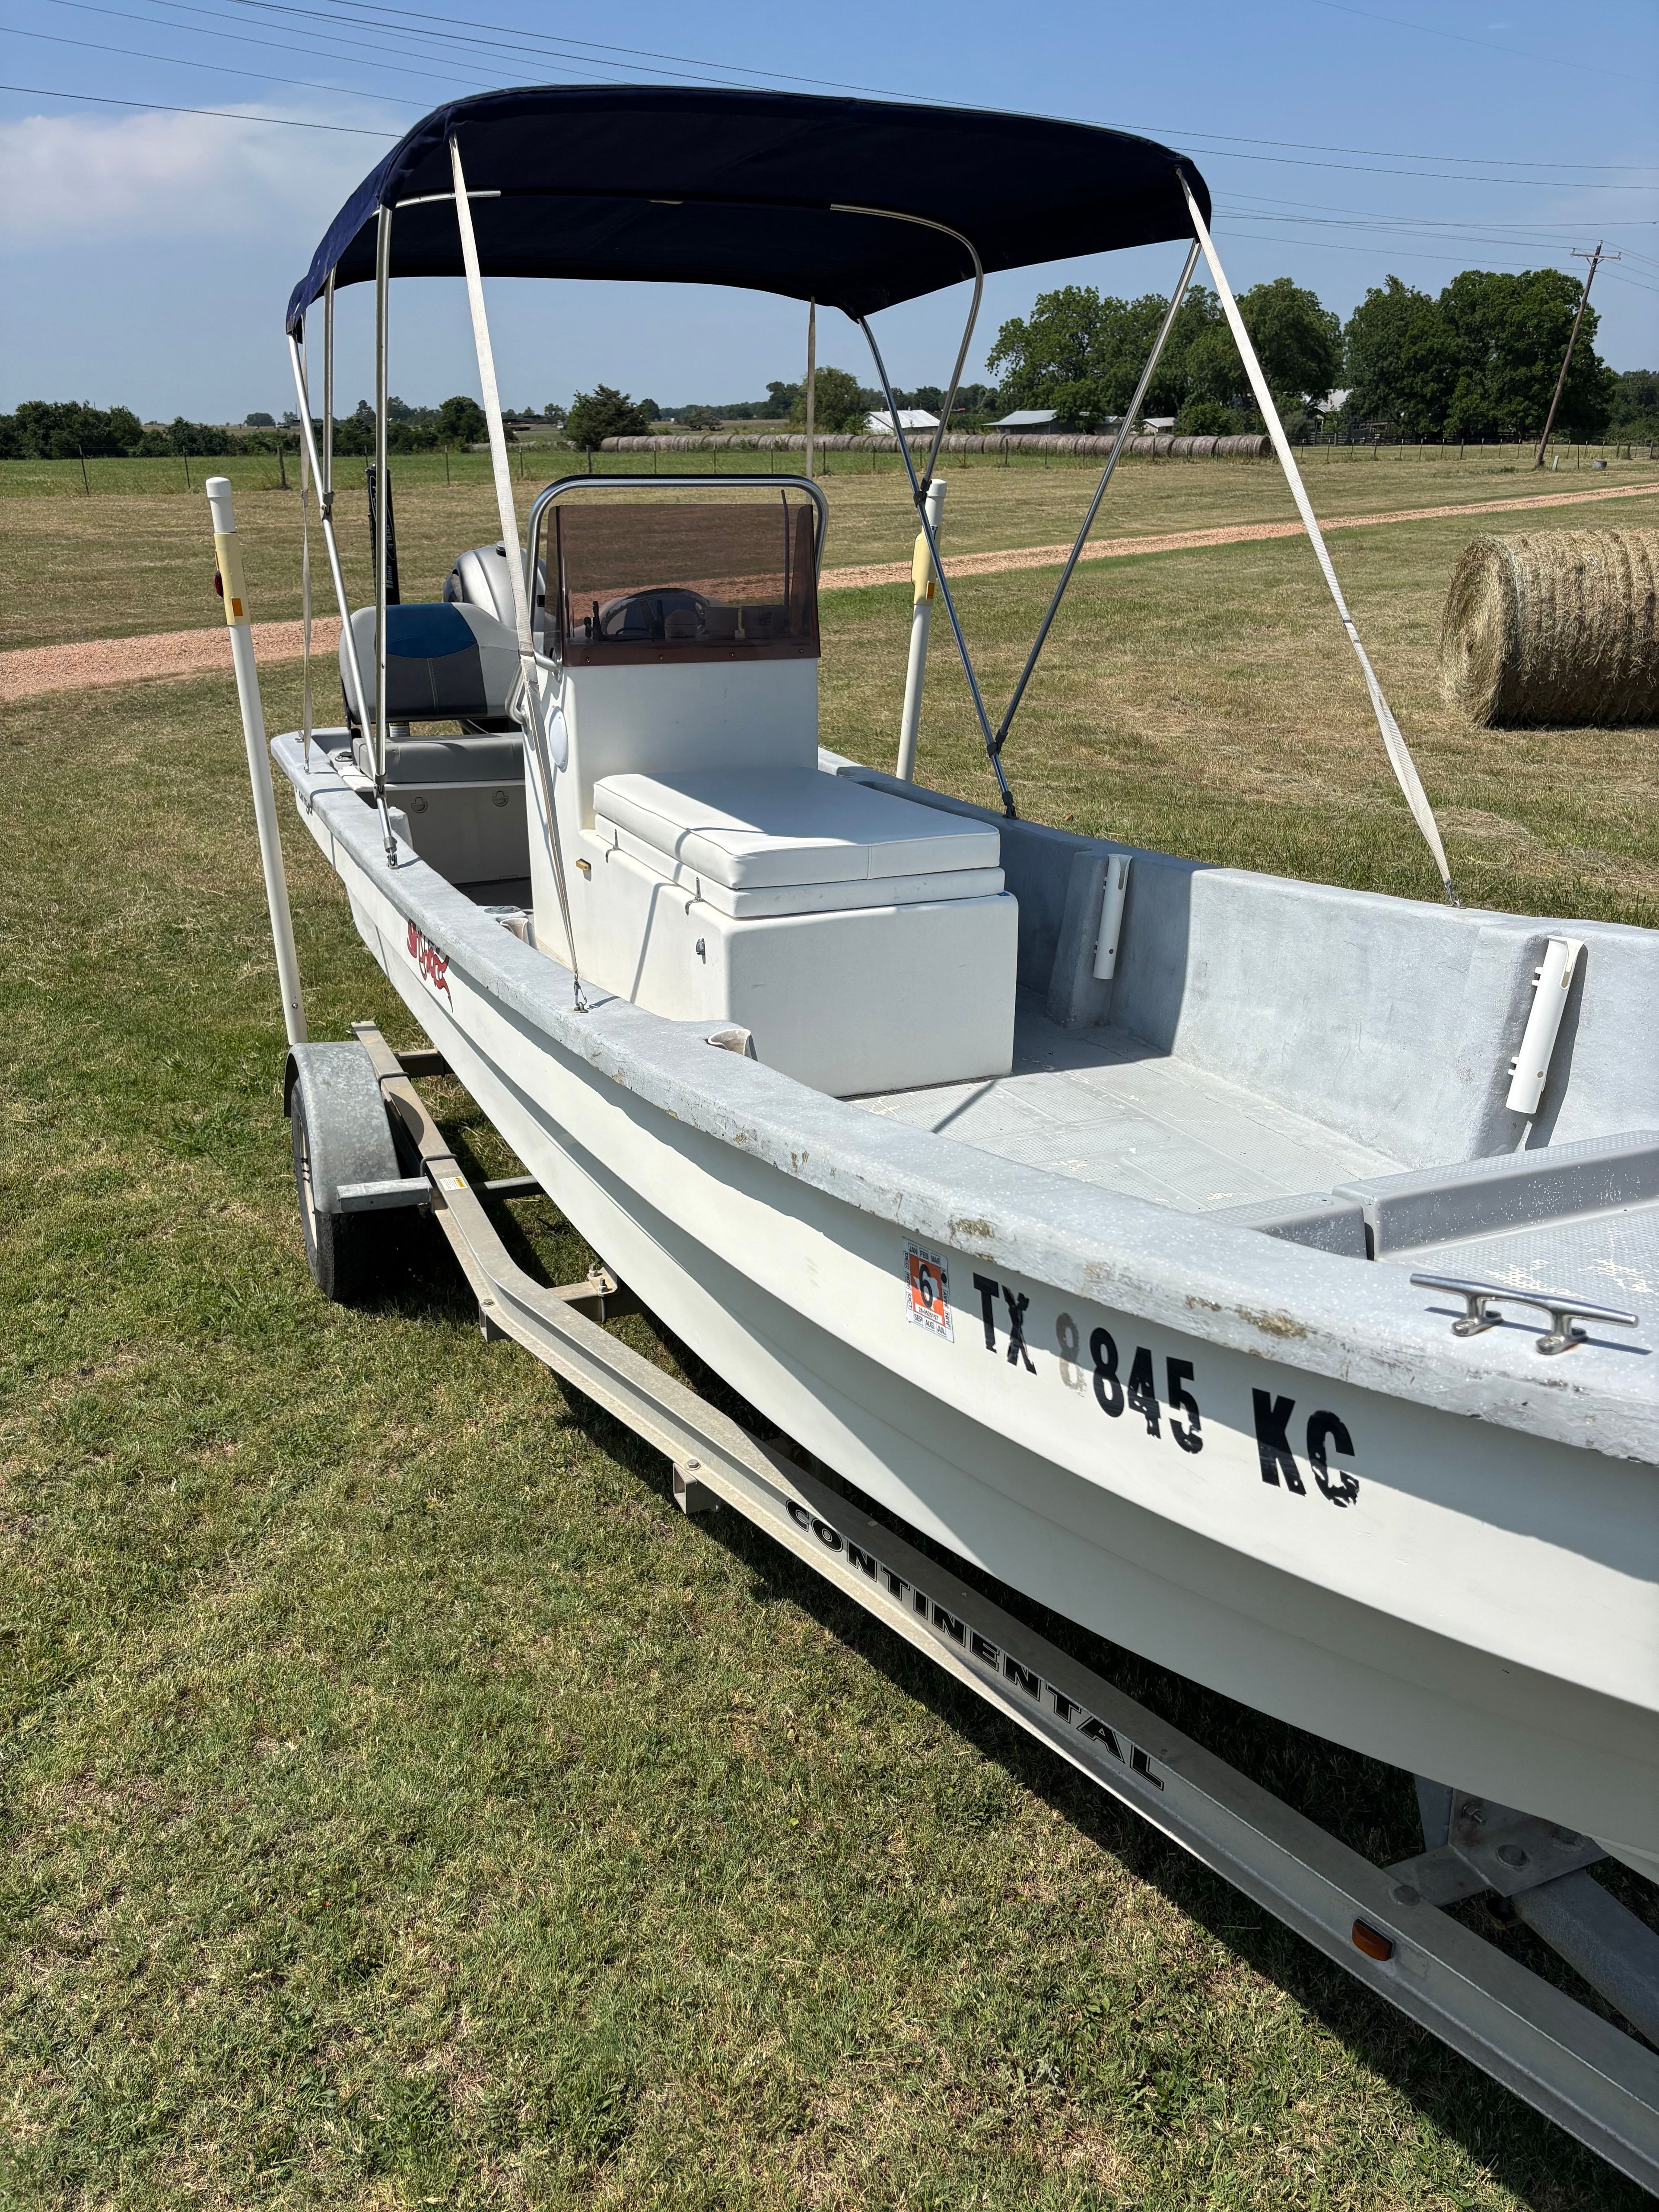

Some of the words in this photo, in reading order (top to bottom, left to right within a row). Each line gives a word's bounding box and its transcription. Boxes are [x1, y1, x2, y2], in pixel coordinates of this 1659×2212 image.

[909, 1246, 918, 1255] JAN
[920, 1251, 928, 1260] FEB
[931, 1255, 940, 1265] MAR
[919, 1264, 933, 1308] 6
[914, 1314, 923, 1322] SEP
[925, 1319, 935, 1329] AUG
[937, 1325, 946, 1335] JUL
[973, 1272, 1037, 1376] TX
[1252, 1387, 1360, 1508] KC
[785, 1499, 1164, 1791] CONTINENTAL
